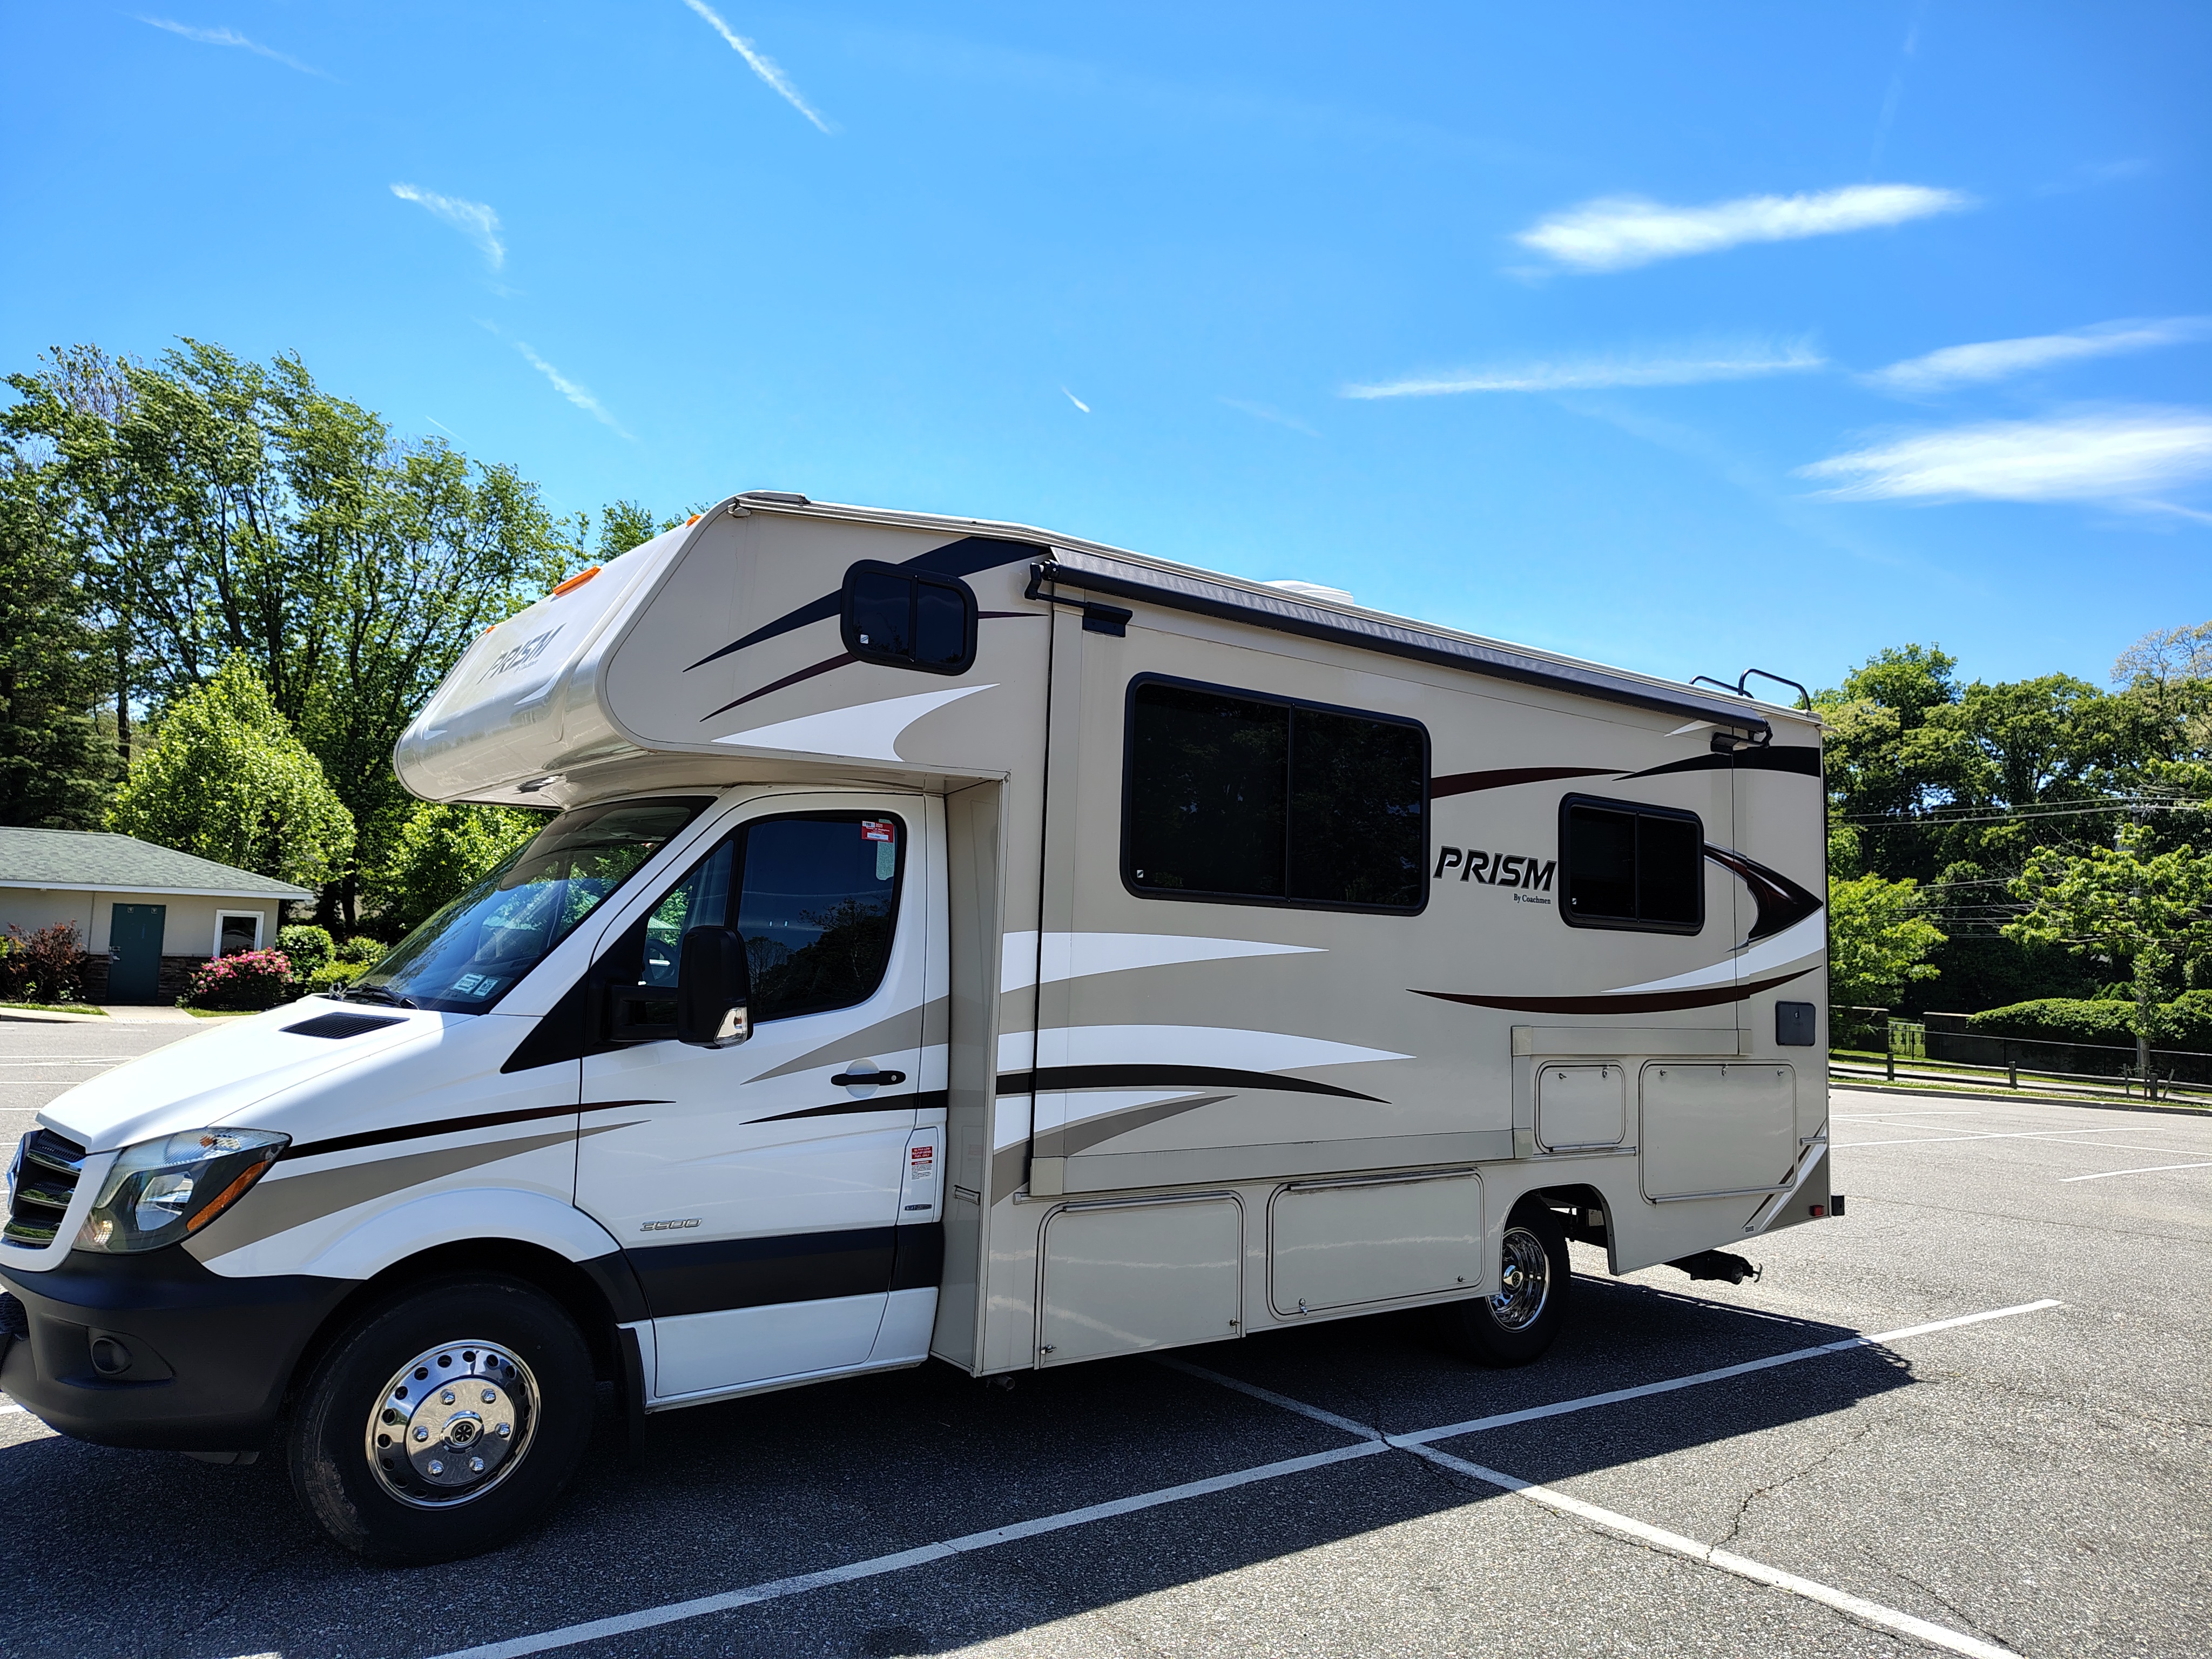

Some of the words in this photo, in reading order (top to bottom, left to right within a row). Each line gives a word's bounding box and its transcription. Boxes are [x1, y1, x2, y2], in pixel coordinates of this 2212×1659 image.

[476, 623, 567, 685] PRISM
[1433, 845, 1557, 892] PRISM
[1514, 893, 1521, 903] By
[1522, 894, 1551, 905] Coachmen
[640, 1217, 702, 1231] 3500
